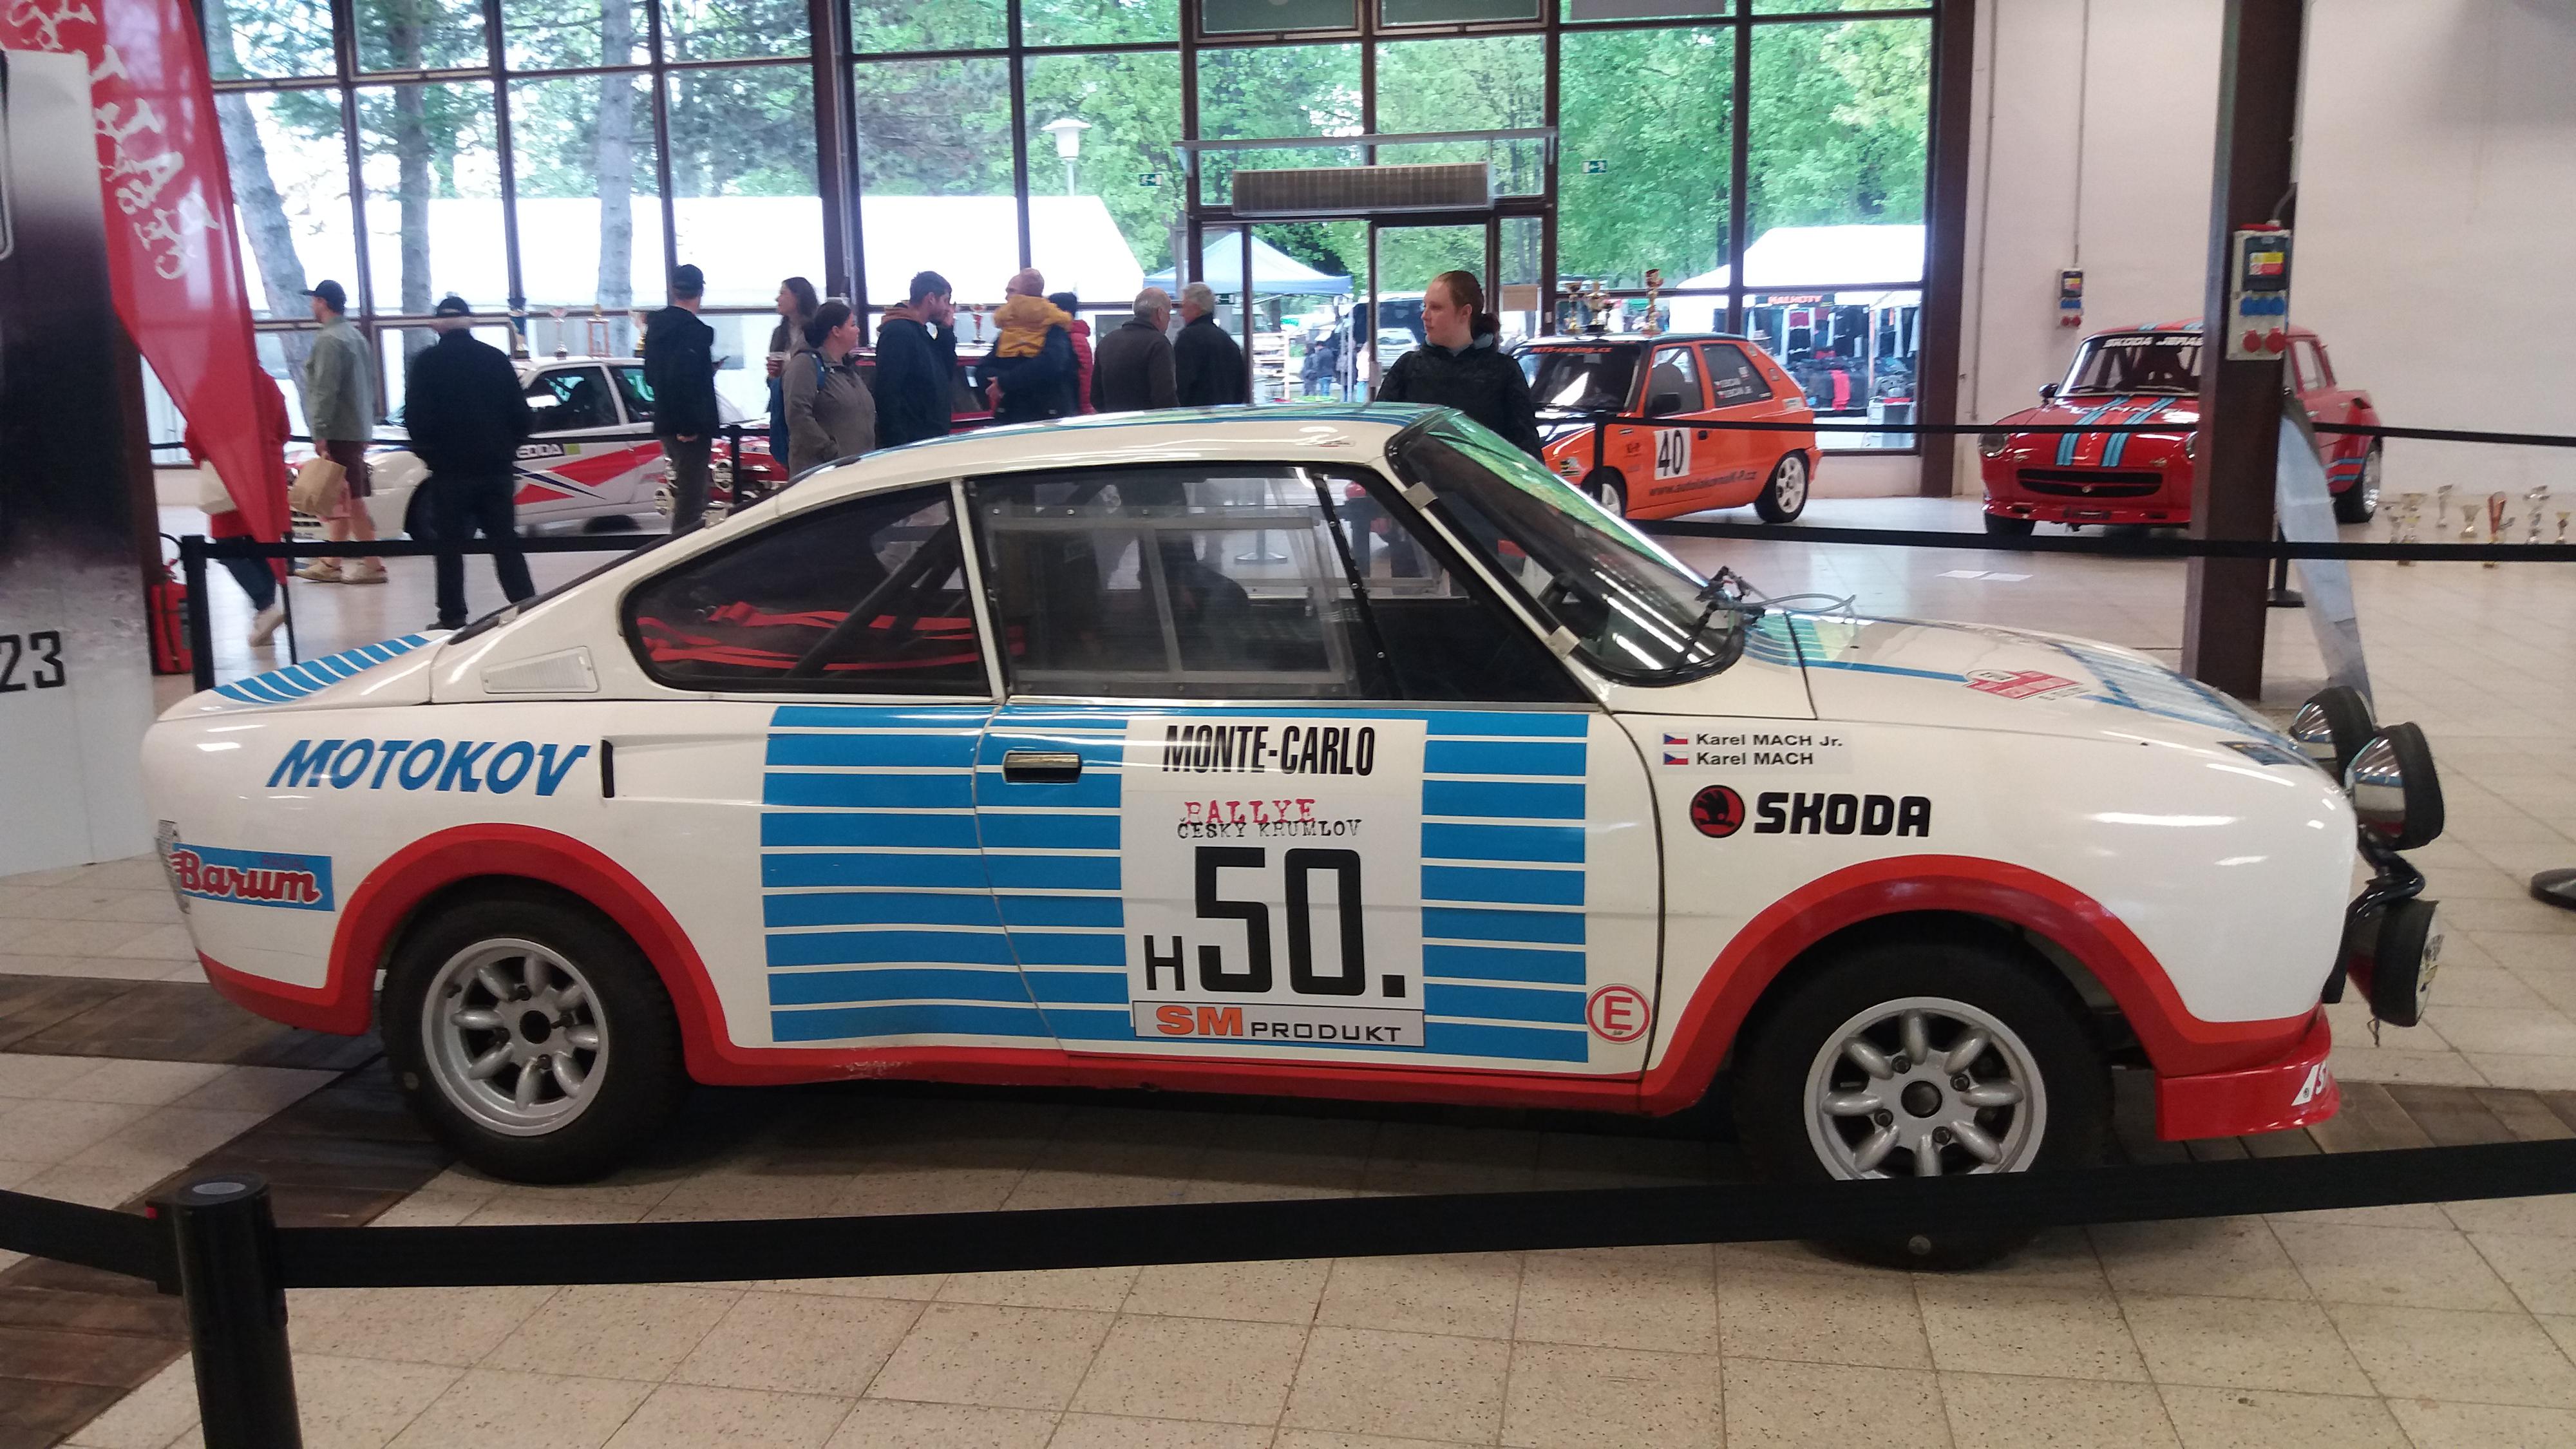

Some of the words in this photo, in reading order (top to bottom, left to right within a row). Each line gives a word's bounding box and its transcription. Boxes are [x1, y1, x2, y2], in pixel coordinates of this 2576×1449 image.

[1657, 430, 1684, 477] 40
[0, 630, 66, 694] 23
[1162, 724, 1375, 776] MONTE-CARLO
[1696, 734, 1745, 745] Karel
[1753, 735, 1812, 746] MACH
[1819, 736, 1842, 746] Jr.
[1696, 752, 1746, 765] Karel
[1754, 752, 1814, 765] MACH
[265, 739, 591, 797] MOTOKOV
[1184, 799, 1316, 824] RALLYE
[1257, 819, 1363, 837] KRUMLOV
[1754, 791, 1931, 837] SKODA
[169, 849, 322, 904] Barum
[1156, 1005, 1244, 1036] SM
[1251, 1021, 1402, 1043] PRODUKT
[1603, 995, 1633, 1031] E
